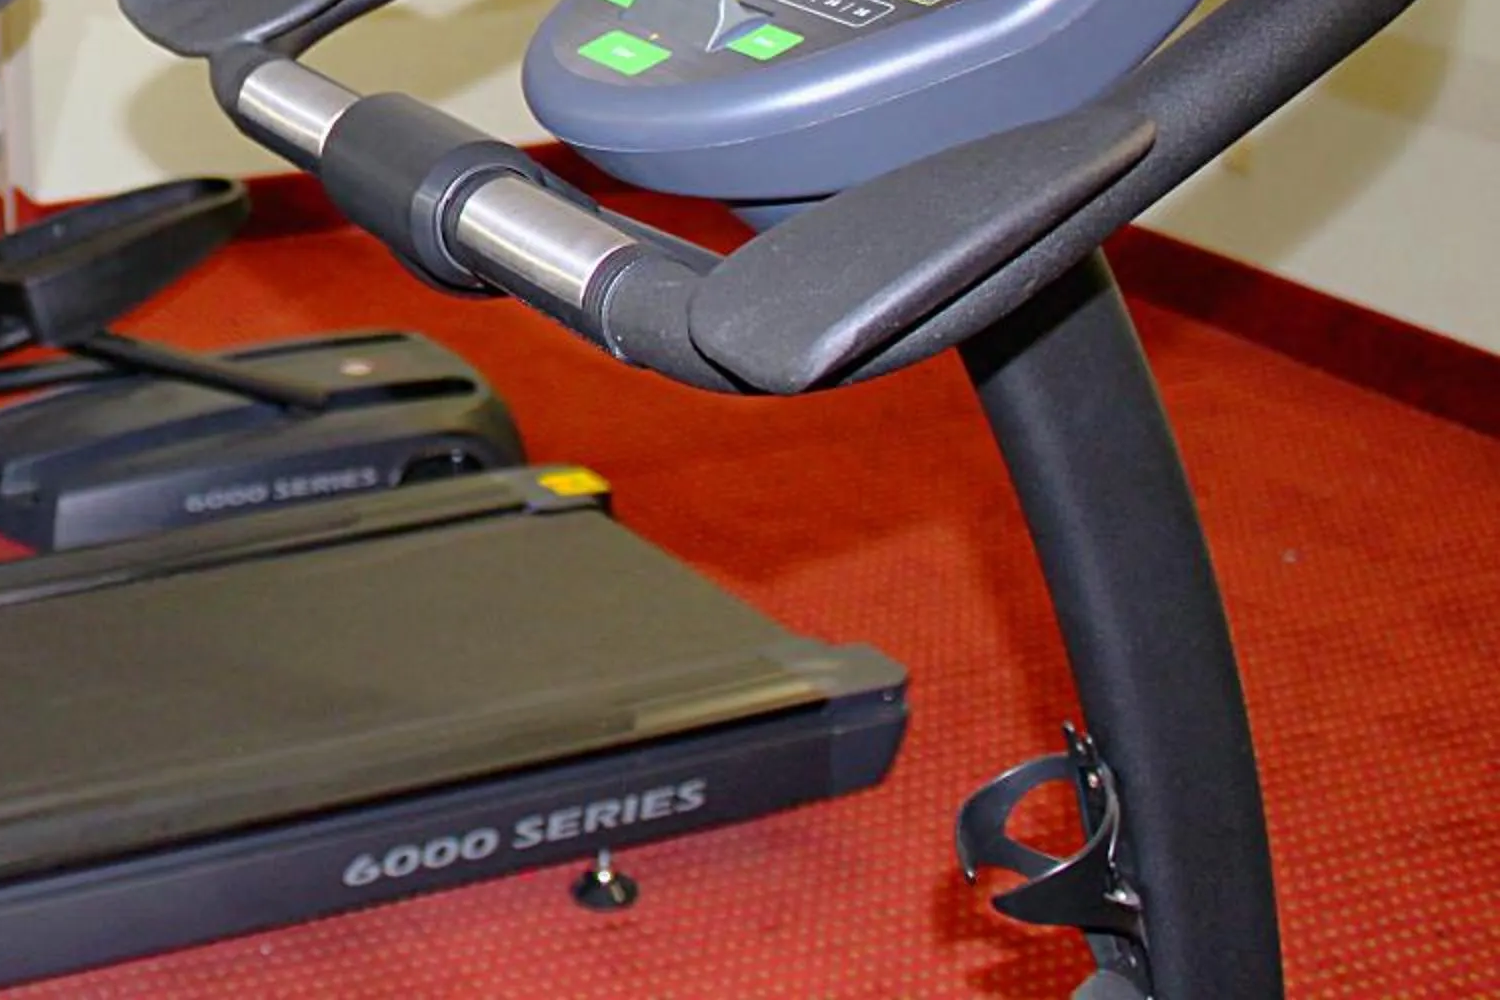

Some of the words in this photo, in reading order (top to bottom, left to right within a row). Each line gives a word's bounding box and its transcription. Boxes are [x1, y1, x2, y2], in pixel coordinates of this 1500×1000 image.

[185, 482, 268, 513] 6000
[272, 467, 377, 501] SERIES
[343, 828, 499, 887] 6000
[512, 778, 707, 851] SERIES
